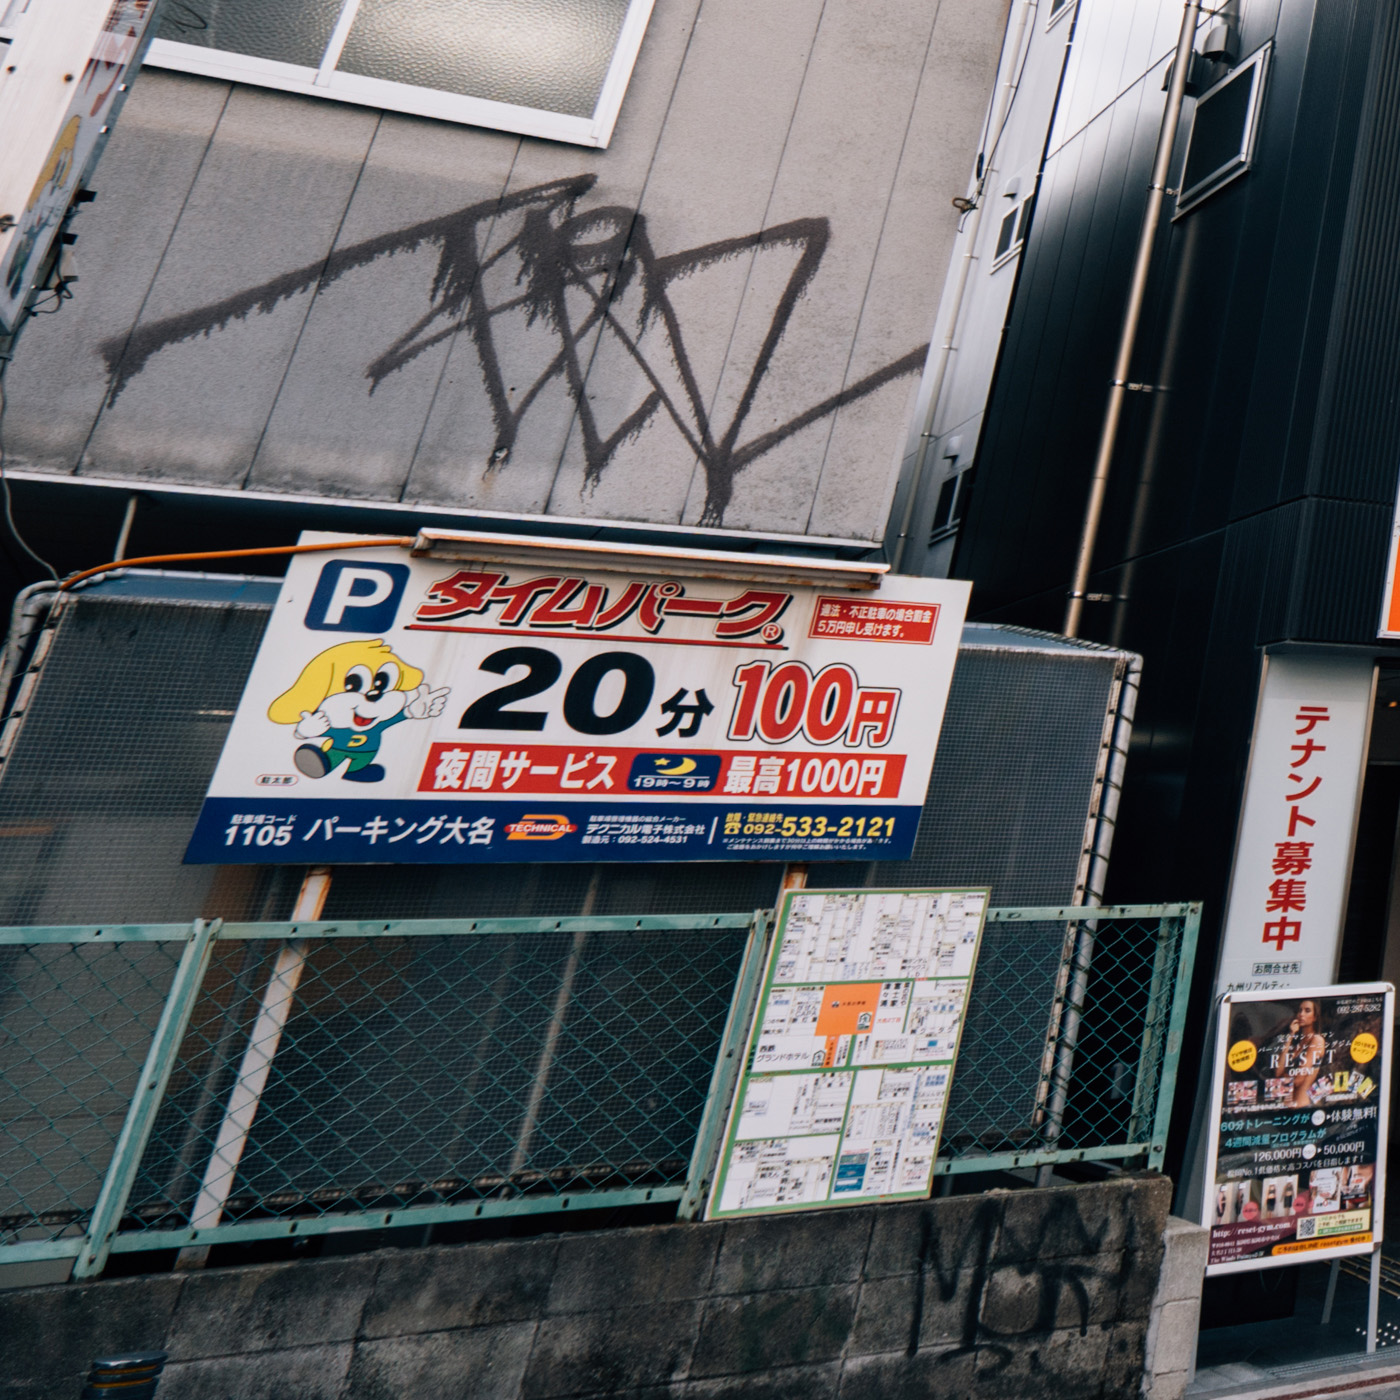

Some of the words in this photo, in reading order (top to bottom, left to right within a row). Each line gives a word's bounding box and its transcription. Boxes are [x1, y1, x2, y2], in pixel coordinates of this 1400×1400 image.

[323, 567, 394, 625] P
[413, 569, 793, 637] タイムパーク
[817, 619, 906, 638] 5万円申し受けます。
[727, 660, 902, 748] 100円
[433, 749, 619, 791] 夜間サービス
[723, 756, 887, 797] 最高1000円
[230, 814, 297, 825] 駐車場コード
[303, 815, 495, 845] パーキング大名
[508, 824, 573, 833] TECHNICAL
[586, 824, 706, 835] テクニカル電子株式会社
[743, 816, 896, 837] 092-533-2121
[1261, 705, 1331, 951] テナント募集中
[225, 825, 293, 846] 1105
[1254, 963, 1300, 976] お問合せ先
[756, 1052, 810, 1063] グランドホテル
[1270, 1049, 1337, 1069] RESET
[1289, 1067, 1316, 1076] OPEN!
[1220, 1114, 1311, 1132] 60分トレーニングが
[1331, 1106, 1378, 1122] 体験無料!
[1225, 1129, 1327, 1149] 4週間減量プログラムが
[1253, 1148, 1303, 1163] 126,000円
[1323, 1141, 1366, 1155] 50,000円
